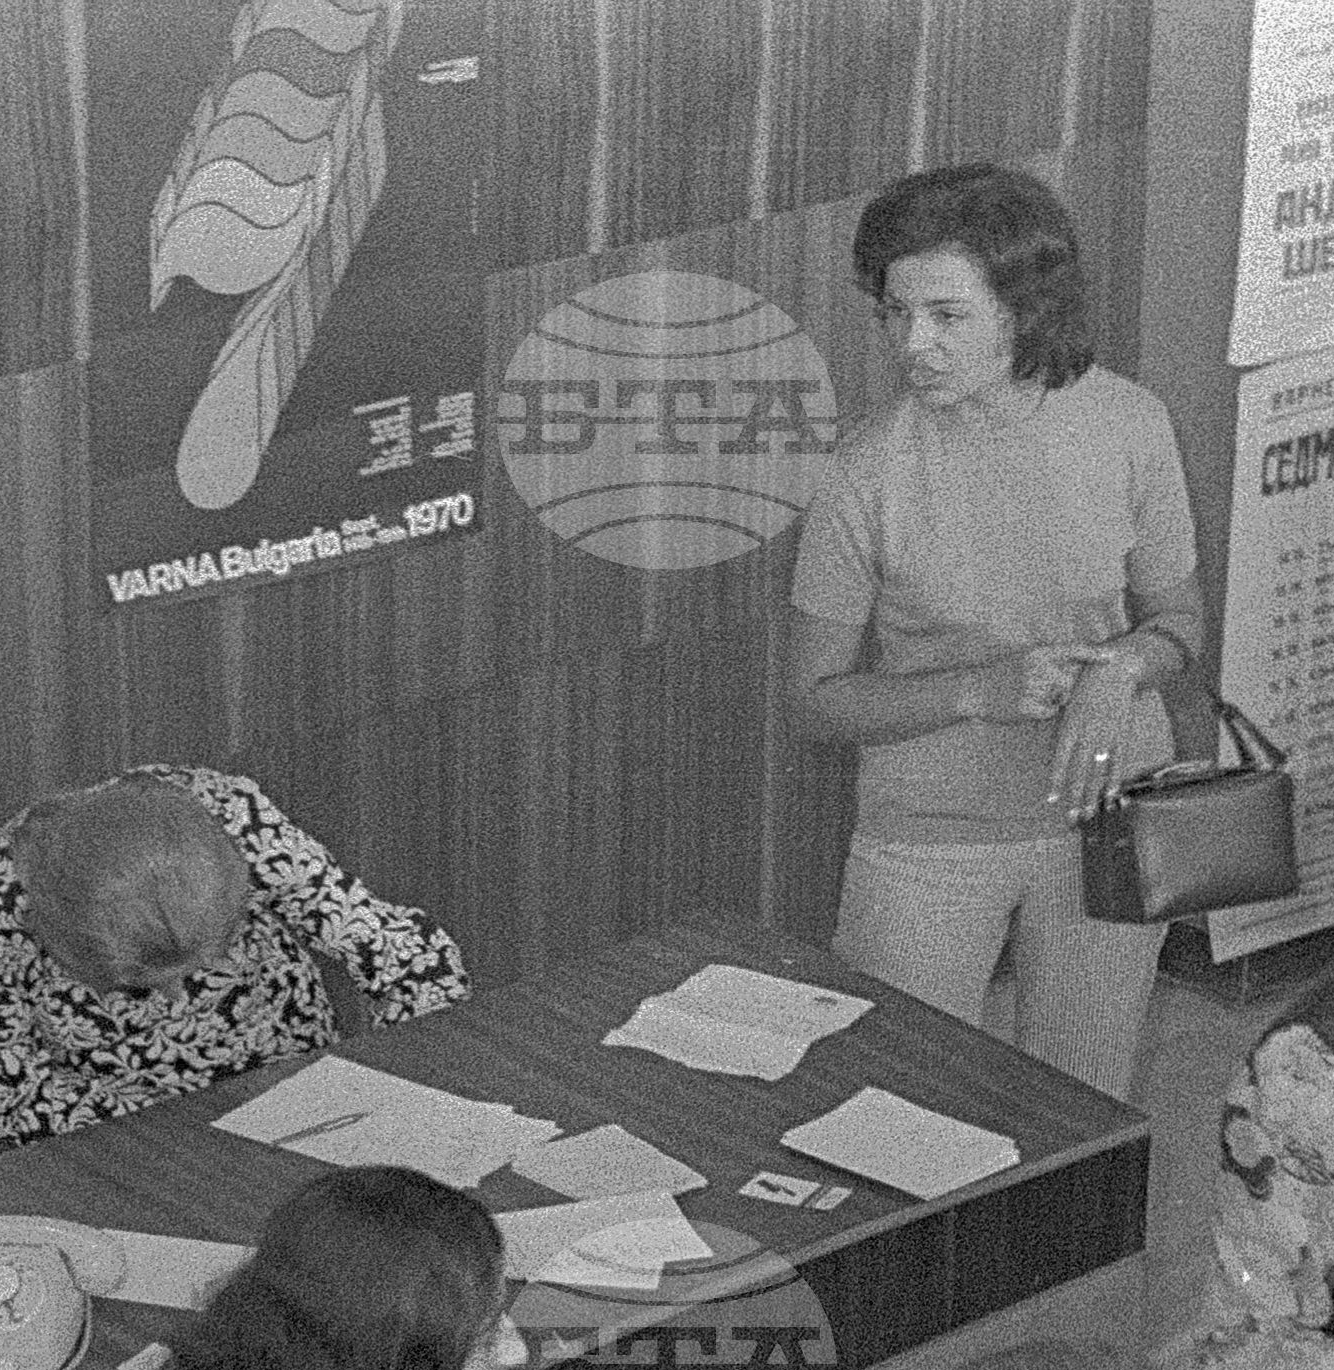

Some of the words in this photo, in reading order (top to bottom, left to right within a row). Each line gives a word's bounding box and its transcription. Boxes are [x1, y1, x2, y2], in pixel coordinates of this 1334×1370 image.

[106, 554, 221, 602] VARNA
[219, 526, 343, 576] Bulgaria
[402, 492, 474, 538] 1970
